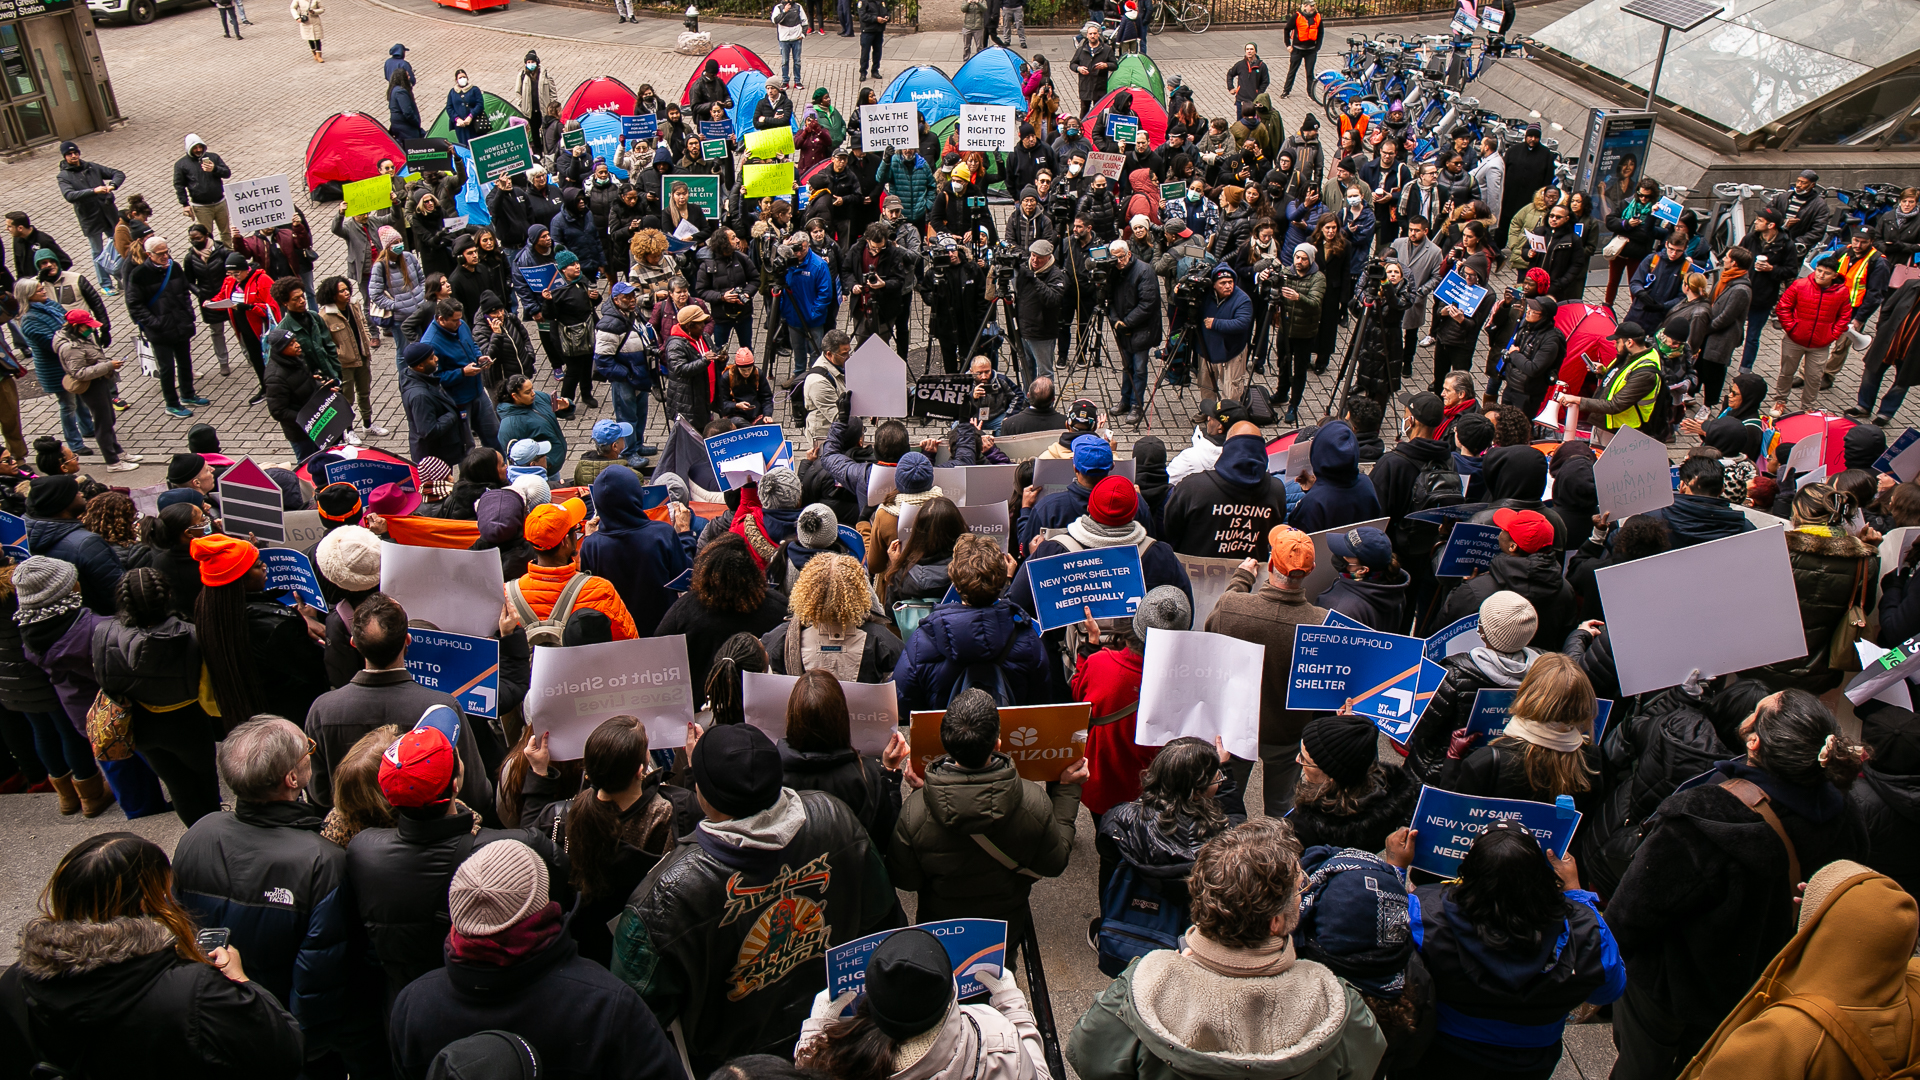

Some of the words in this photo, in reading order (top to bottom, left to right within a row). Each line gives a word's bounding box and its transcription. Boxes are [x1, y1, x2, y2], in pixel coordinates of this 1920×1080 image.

[18, 5, 45, 15] Station
[869, 113, 890, 122] SAVE
[893, 112, 908, 120] THE
[968, 114, 988, 122] SAVE
[870, 126, 895, 134] RIGHT
[484, 141, 515, 154] HOMELESS
[870, 138, 910, 148] SHELTER!
[967, 139, 1005, 147] SHELTER!
[493, 149, 509, 158] YORK
[511, 144, 524, 152] CITY
[1109, 154, 1124, 163] ADAMS
[235, 189, 260, 201] SAVE
[263, 185, 280, 196] THE
[762, 184, 786, 194] BENCHES
[239, 202, 268, 215] RIGHT
[269, 199, 283, 209] TO
[355, 199, 382, 212] SHELTER
[241, 212, 286, 228] SHELTER!
[919, 384, 971, 393] HEALTH
[918, 389, 966, 405] CARE
[314, 412, 321, 420] to
[319, 393, 338, 414] Shelter
[321, 409, 335, 424] Lives
[710, 436, 737, 449] DEFEND
[744, 430, 769, 440] UPHOLD
[713, 448, 727, 457] THE
[1609, 439, 1650, 458] Housing
[1622, 458, 1634, 466] is
[331, 463, 359, 474] DEFEND
[1624, 470, 1631, 479] A
[333, 474, 347, 482] THE
[1606, 471, 1657, 494] HUMAN
[1613, 484, 1655, 508] RIGHT
[1212, 504, 1272, 519] HOUSING
[1230, 518, 1242, 528] IS
[1242, 519, 1252, 530] A
[1214, 530, 1260, 542] HUMAN
[1218, 541, 1256, 553] RIGHT
[1472, 540, 1492, 548] YORK
[1063, 562, 1076, 570] NY
[1077, 558, 1103, 567] SANE:
[271, 566, 290, 574] YORK
[291, 566, 312, 578] SHELTER
[1040, 577, 1061, 588] NEW
[1062, 572, 1088, 583] YORK
[1089, 567, 1131, 577] SHELTER
[272, 575, 289, 583] FOR
[290, 584, 314, 594] EQUALLY
[1062, 585, 1082, 596] FOR
[1084, 583, 1102, 591] ALL
[1102, 581, 1112, 589] IN
[1055, 597, 1082, 609] NEED
[1082, 592, 1125, 603] EQUALLY
[1301, 633, 1340, 644] DEFEND
[1342, 636, 1349, 645] &
[1350, 637, 1393, 650] UPHOLD
[1429, 633, 1449, 651] DEFEND
[1454, 620, 1478, 637] UPHOLD
[426, 637, 432, 645] &
[434, 638, 472, 651] UPHOLD
[1300, 647, 1319, 656] THE
[1429, 649, 1439, 660] THE
[404, 660, 423, 668] GHT
[426, 663, 441, 673] TO
[1298, 664, 1335, 674] RIGHT
[1336, 665, 1351, 675] TO
[412, 674, 439, 687] LTER
[1295, 679, 1346, 690] SHELTER
[1378, 708, 1397, 718] SANE
[1377, 719, 1396, 734] SANE
[1008, 747, 1074, 762] rizon
[1469, 808, 1488, 818] NY
[1488, 810, 1523, 820] SANE:
[1426, 815, 1458, 828] NEW
[1460, 822, 1484, 833] YOR
[1433, 845, 1468, 860] NEED
[836, 940, 885, 961] DEFEN
[836, 957, 864, 971] THE
[837, 971, 866, 985] RIG
[961, 982, 974, 990] NY
[961, 984, 984, 995] SANE
